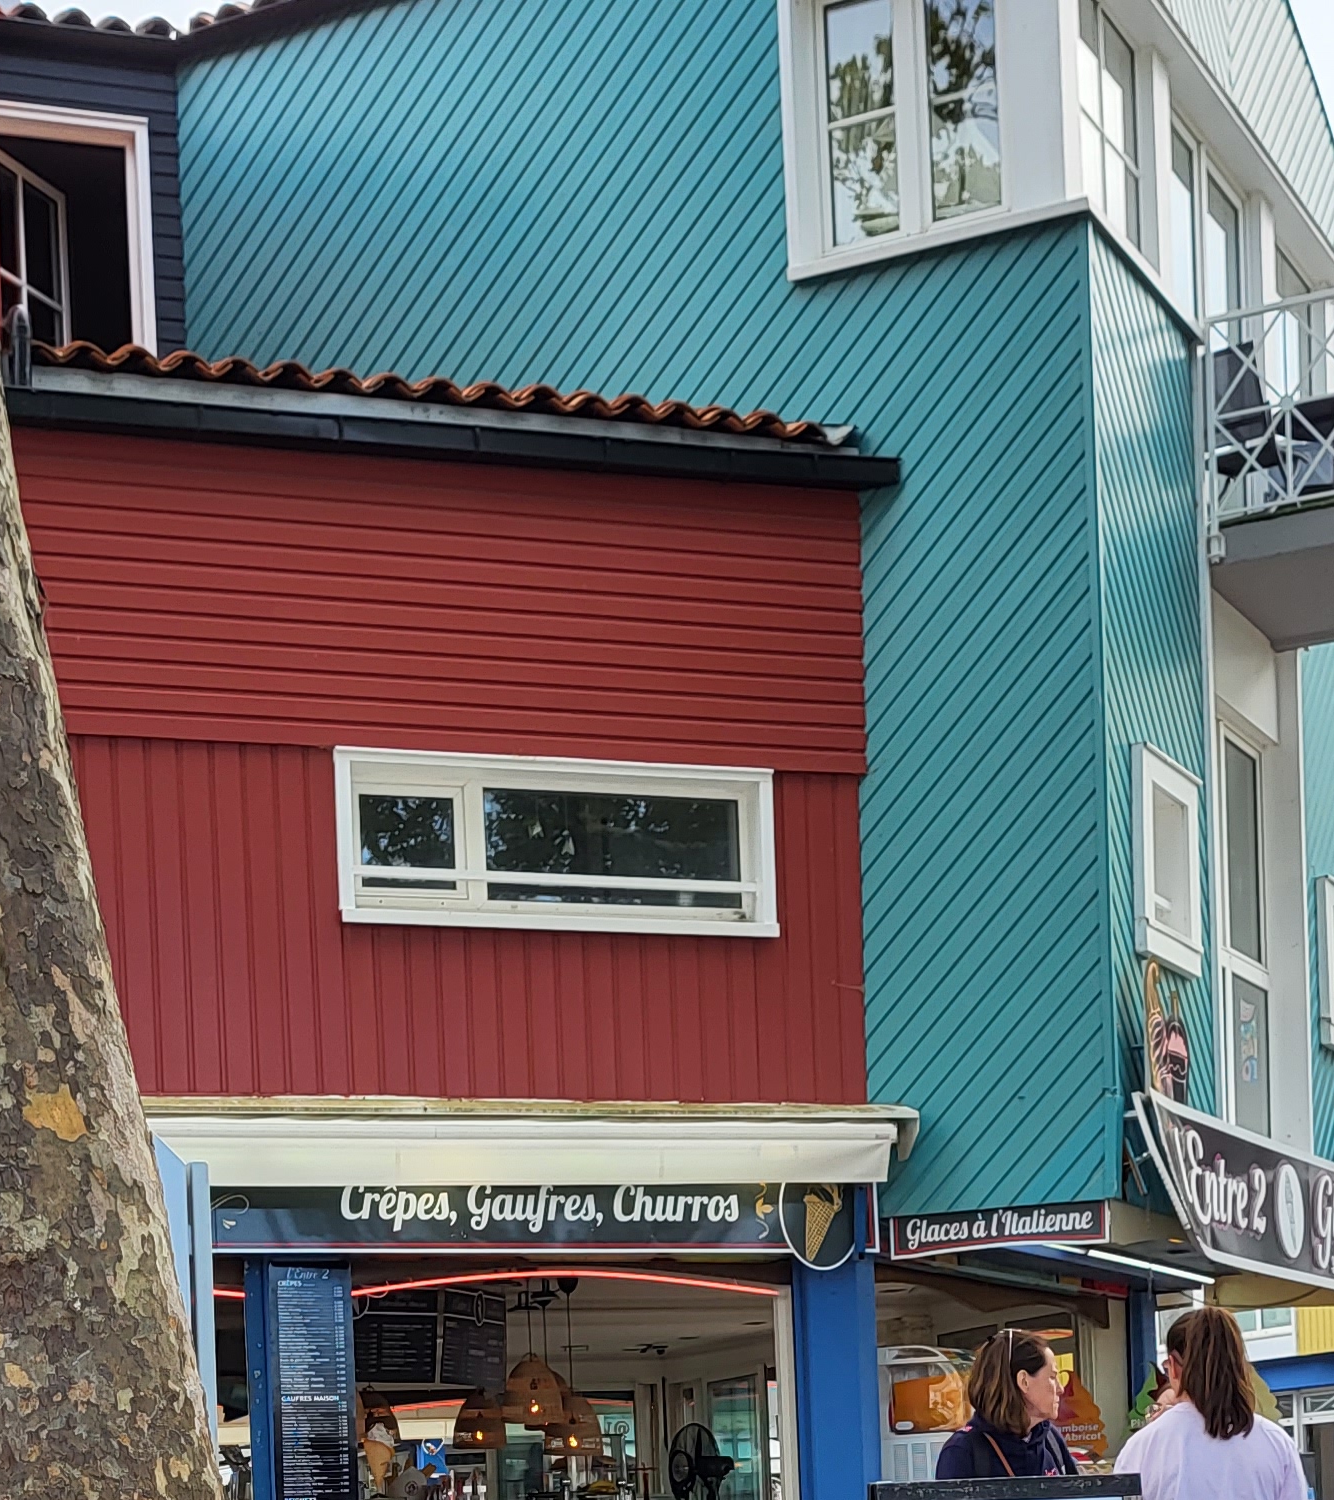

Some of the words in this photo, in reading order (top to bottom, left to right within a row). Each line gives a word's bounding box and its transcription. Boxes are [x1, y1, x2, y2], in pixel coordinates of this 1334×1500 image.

[340, 1184, 458, 1232] Crêpes,
[466, 1184, 604, 1234] Gaufres,
[612, 1184, 740, 1224] Churros
[1251, 1167, 1267, 1235] 2
[906, 1218, 969, 1250] Glaces
[971, 1212, 989, 1239] à
[990, 1208, 1094, 1237] l'Italienne
[321, 1268, 330, 1280] 2
